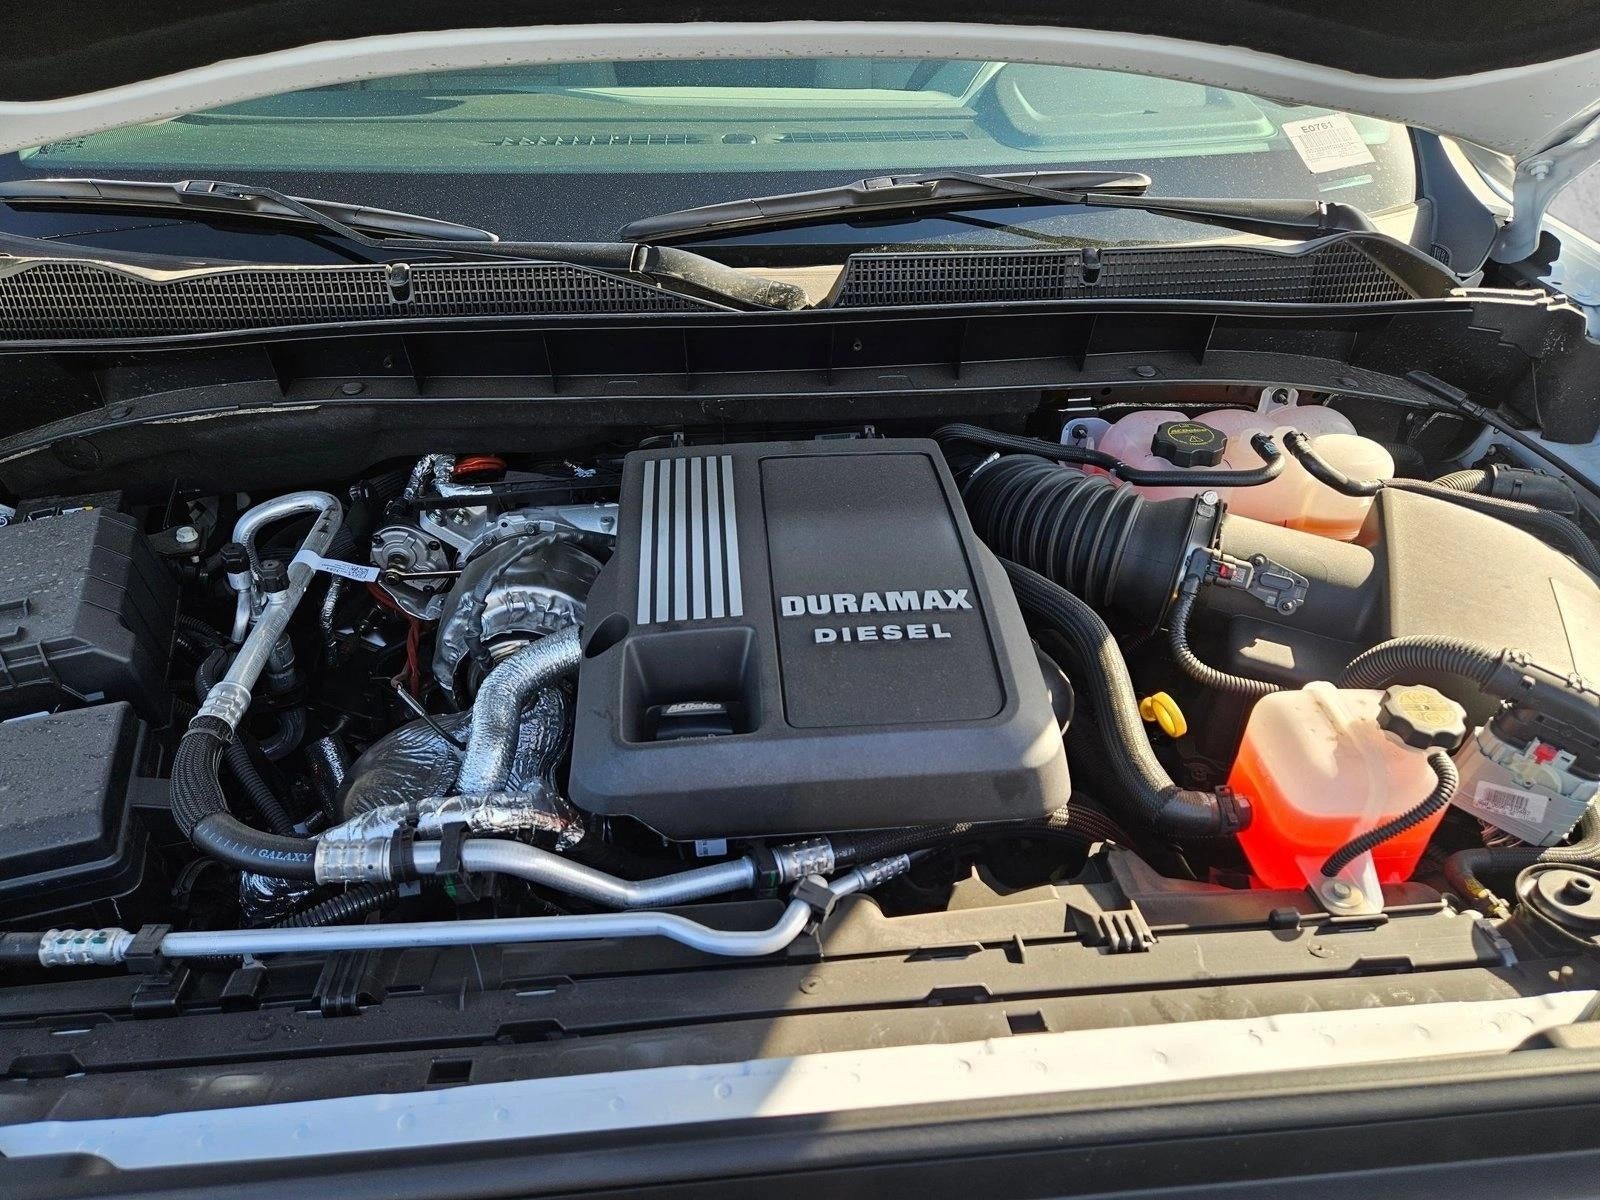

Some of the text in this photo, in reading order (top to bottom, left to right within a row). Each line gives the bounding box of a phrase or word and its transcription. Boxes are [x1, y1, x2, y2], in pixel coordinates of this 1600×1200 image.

[1300, 121, 1334, 134] E0761
[780, 589, 973, 617] DURAMAX
[814, 623, 952, 643] DIESEL
[258, 849, 312, 862] GALAXY
